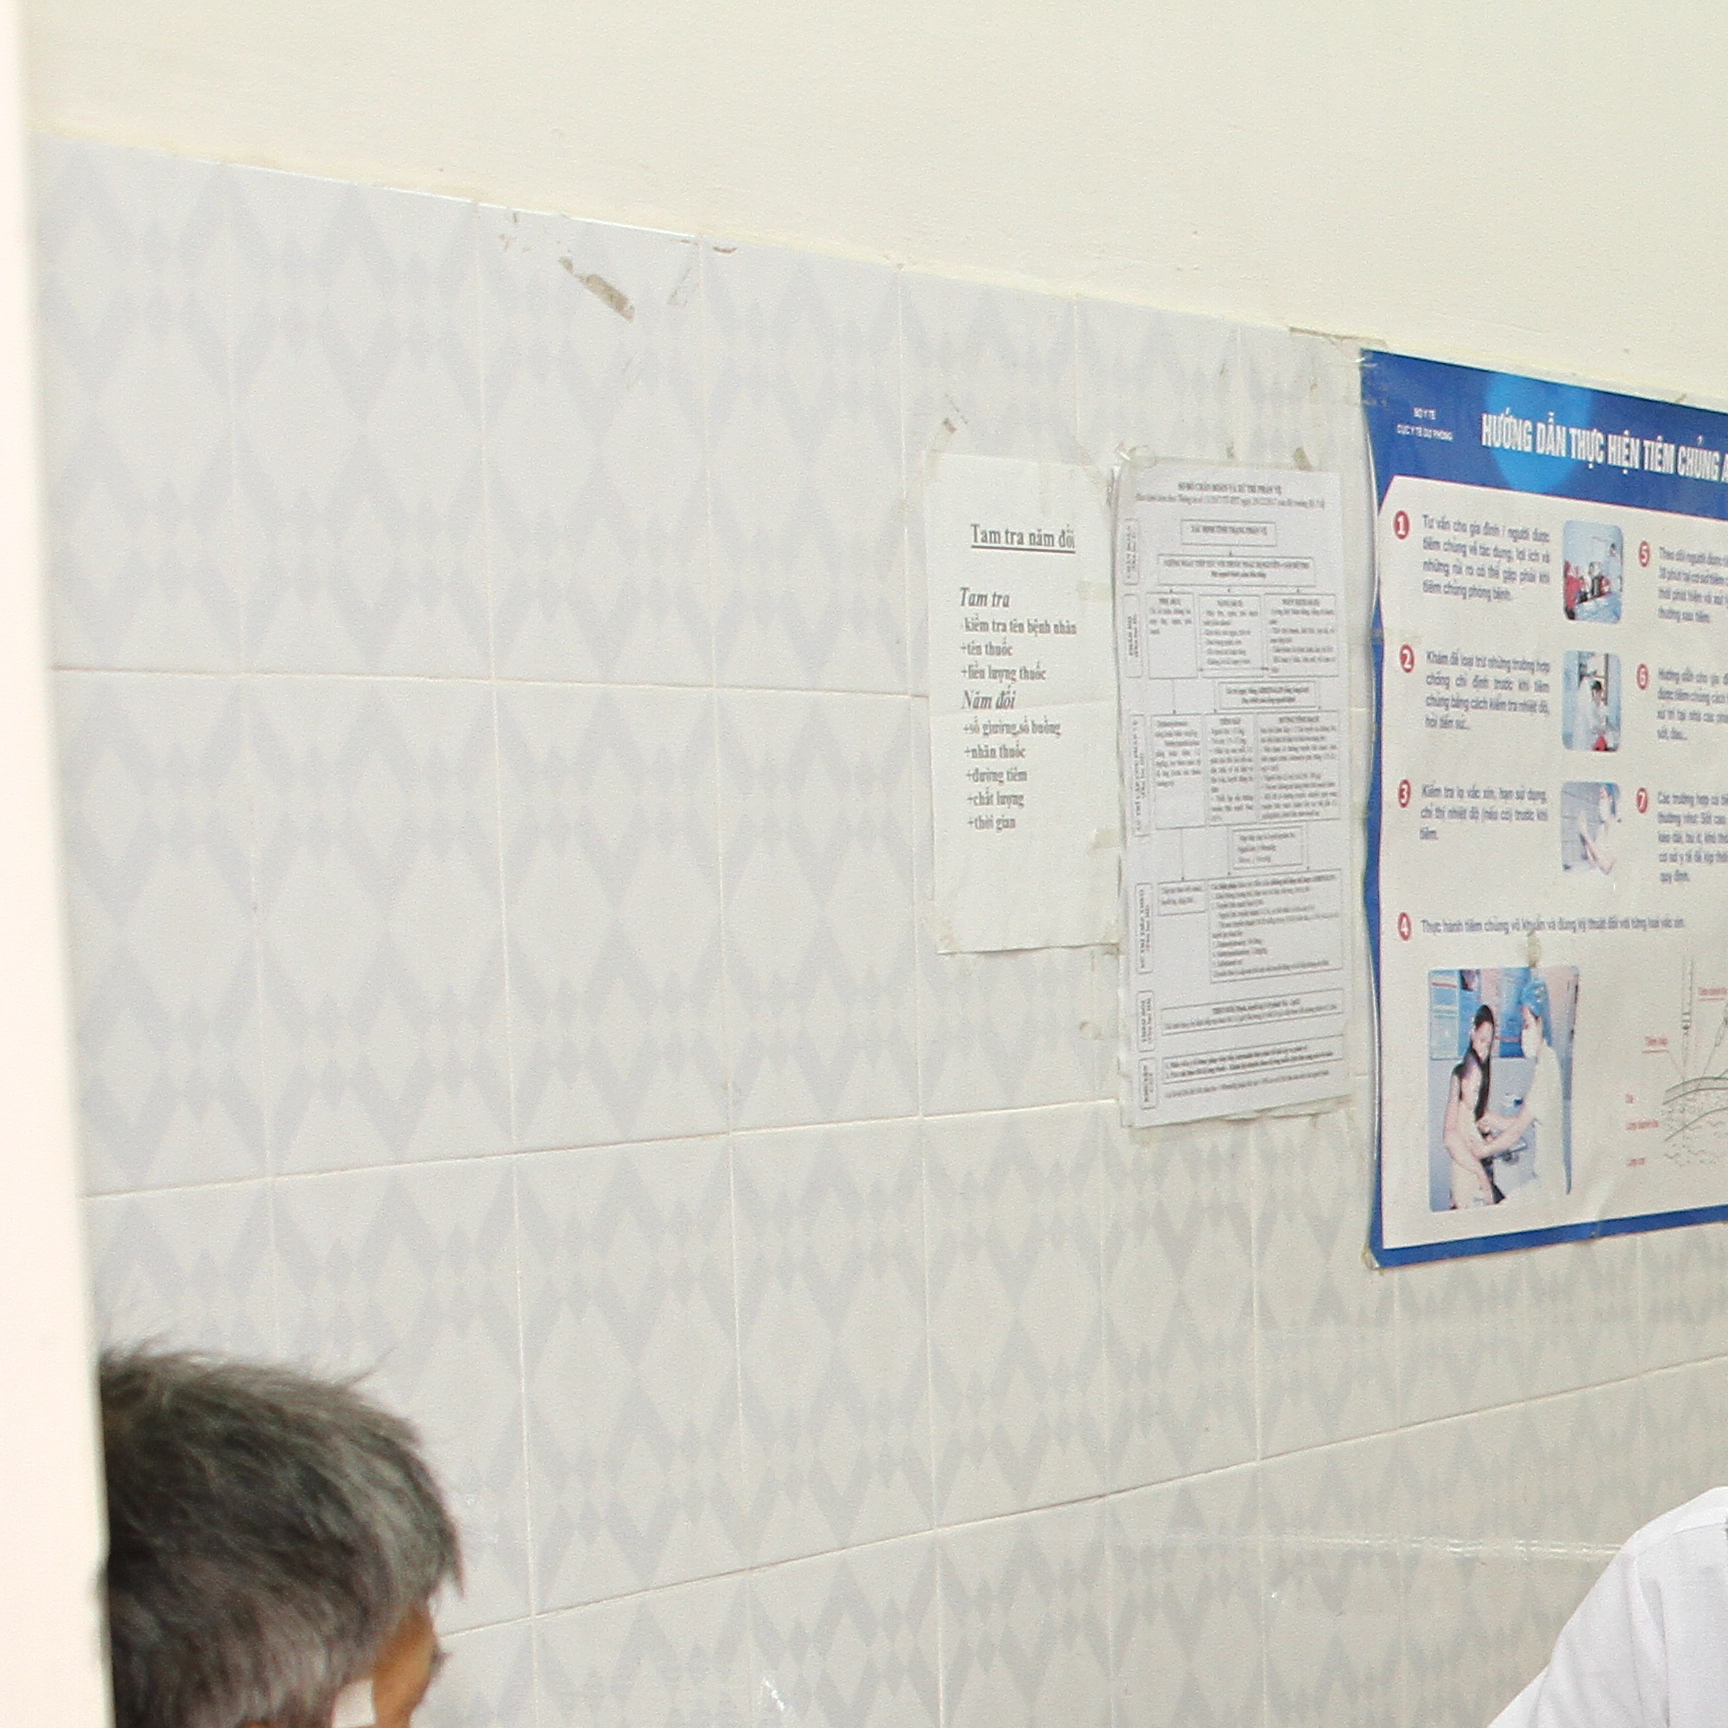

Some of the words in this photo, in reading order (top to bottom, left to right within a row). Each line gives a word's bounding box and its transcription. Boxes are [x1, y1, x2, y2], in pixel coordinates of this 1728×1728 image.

[1482, 408, 1532, 452] HƯỚNG
[1537, 412, 1566, 457] DẪN
[1569, 428, 1604, 468] THỰC
[1608, 430, 1639, 474] HIỆN
[1644, 435, 1675, 474] TIÊM
[1678, 436, 1719, 481] CHỦNG
[971, 524, 1000, 543] Tam
[1005, 529, 1024, 545] tra
[960, 587, 987, 607] Tam
[992, 591, 1010, 608] tra
[992, 619, 1007, 633] tra
